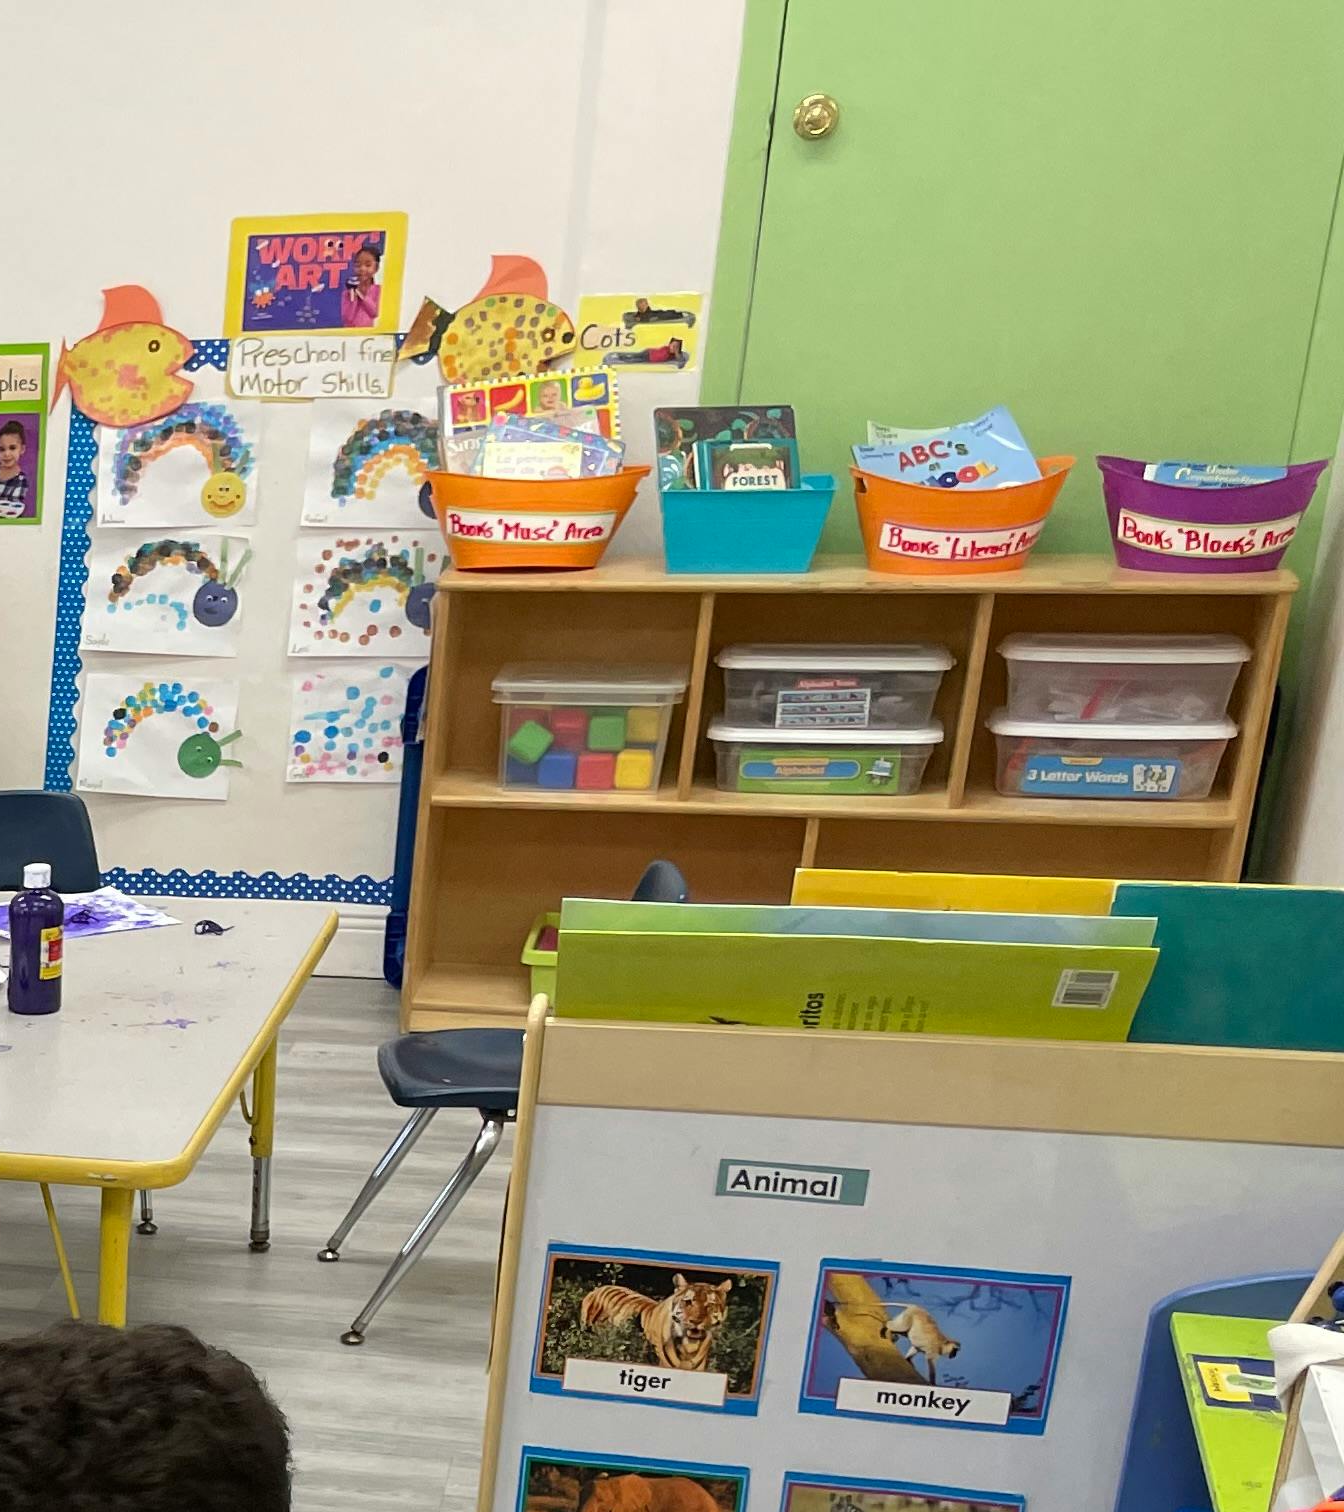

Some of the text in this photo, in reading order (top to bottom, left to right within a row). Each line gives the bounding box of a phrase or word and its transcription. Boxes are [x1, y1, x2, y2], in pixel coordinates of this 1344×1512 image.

[274, 263, 348, 291] ART
[579, 323, 637, 350] Cots
[238, 337, 346, 368] Preschool
[239, 375, 309, 395] Motor
[732, 475, 778, 487] FOREST
[1026, 769, 1130, 784] 3 Letter Words
[797, 991, 825, 1030] ritos
[729, 1168, 839, 1199] Animal
[618, 1368, 672, 1394] tiger
[875, 1388, 972, 1418] monkey
